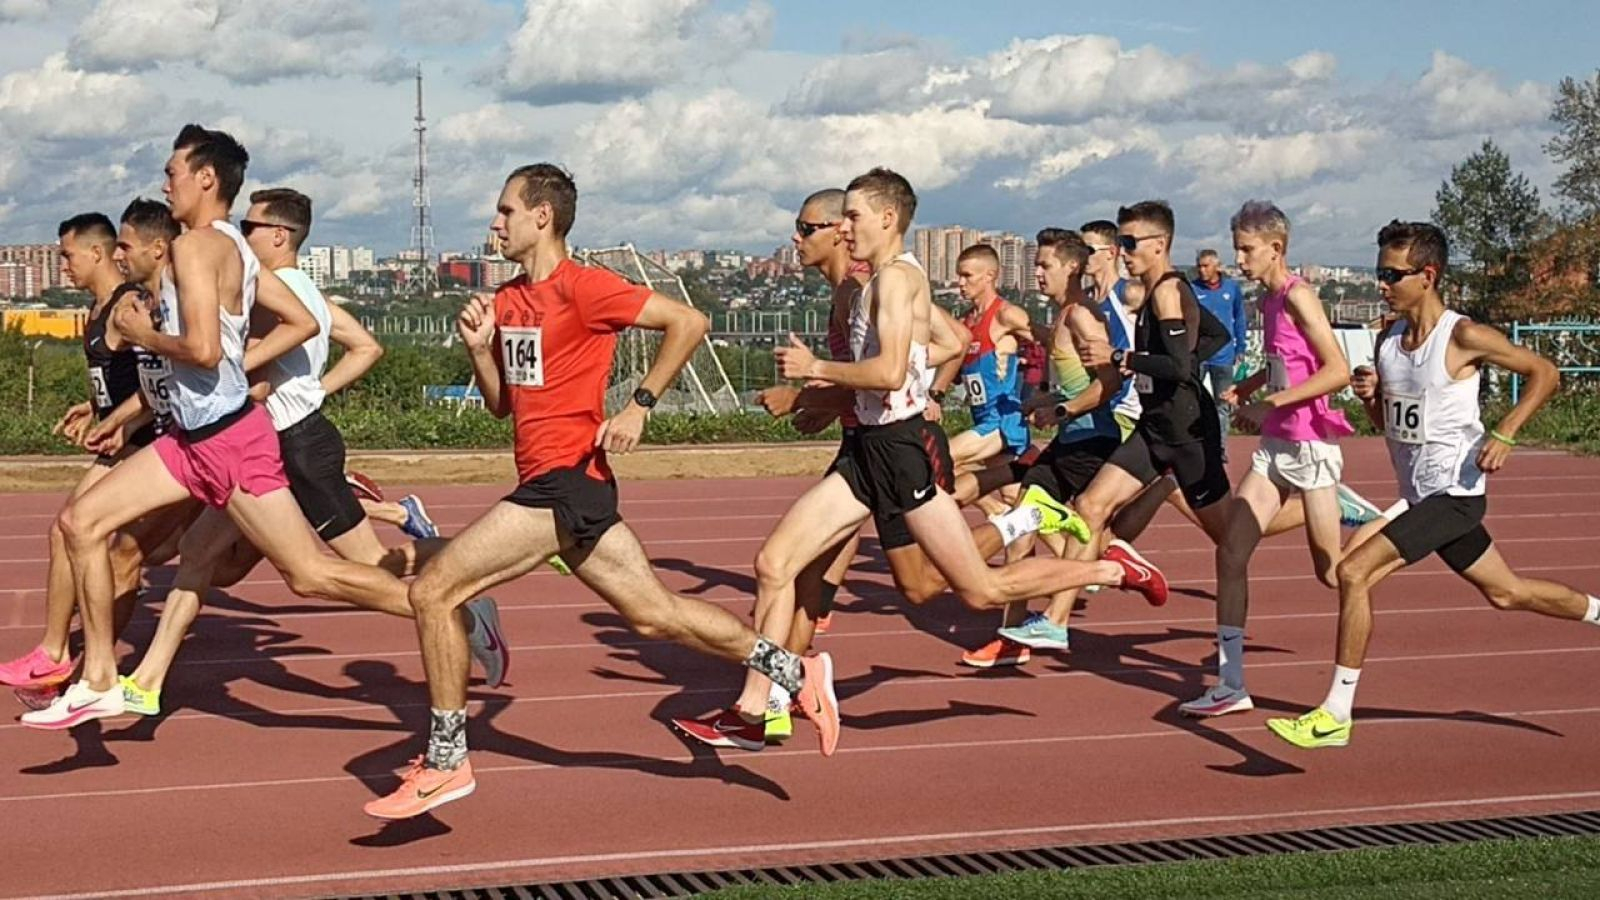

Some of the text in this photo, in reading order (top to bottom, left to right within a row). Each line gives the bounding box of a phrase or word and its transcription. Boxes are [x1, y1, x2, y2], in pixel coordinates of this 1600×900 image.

[505, 338, 537, 368] 164
[93, 376, 105, 396] 2
[1384, 399, 1420, 430] 116
